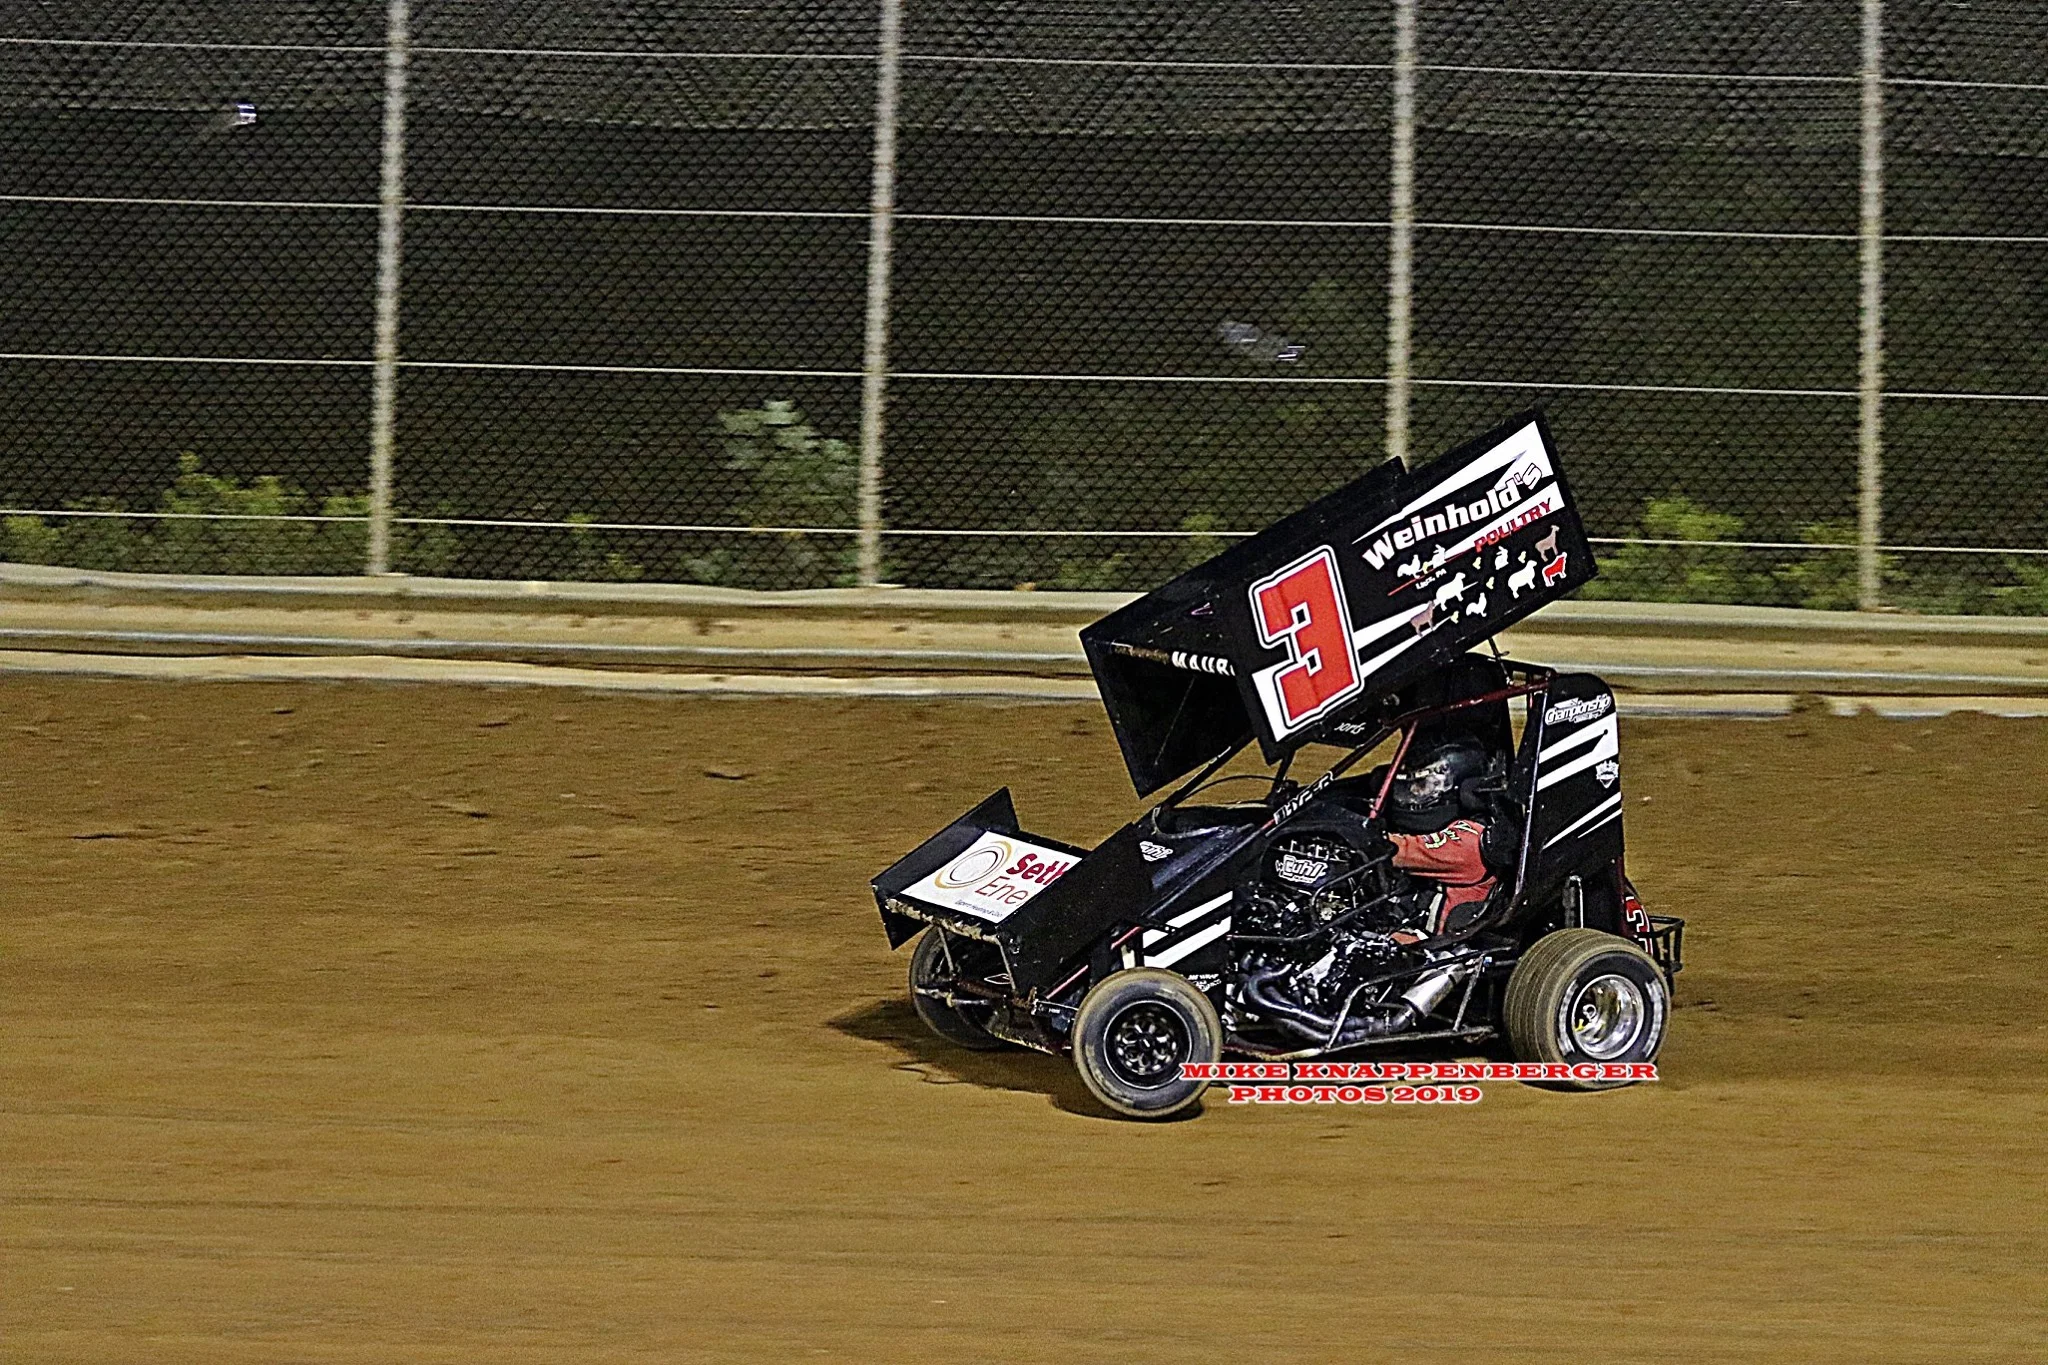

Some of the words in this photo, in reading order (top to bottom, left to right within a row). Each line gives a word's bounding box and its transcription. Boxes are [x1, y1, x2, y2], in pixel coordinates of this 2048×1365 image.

[1362, 463, 1542, 571] Weinhold's
[1474, 497, 1552, 553] POULTRY
[1250, 546, 1363, 729] 3
[975, 875, 1029, 907] Ene
